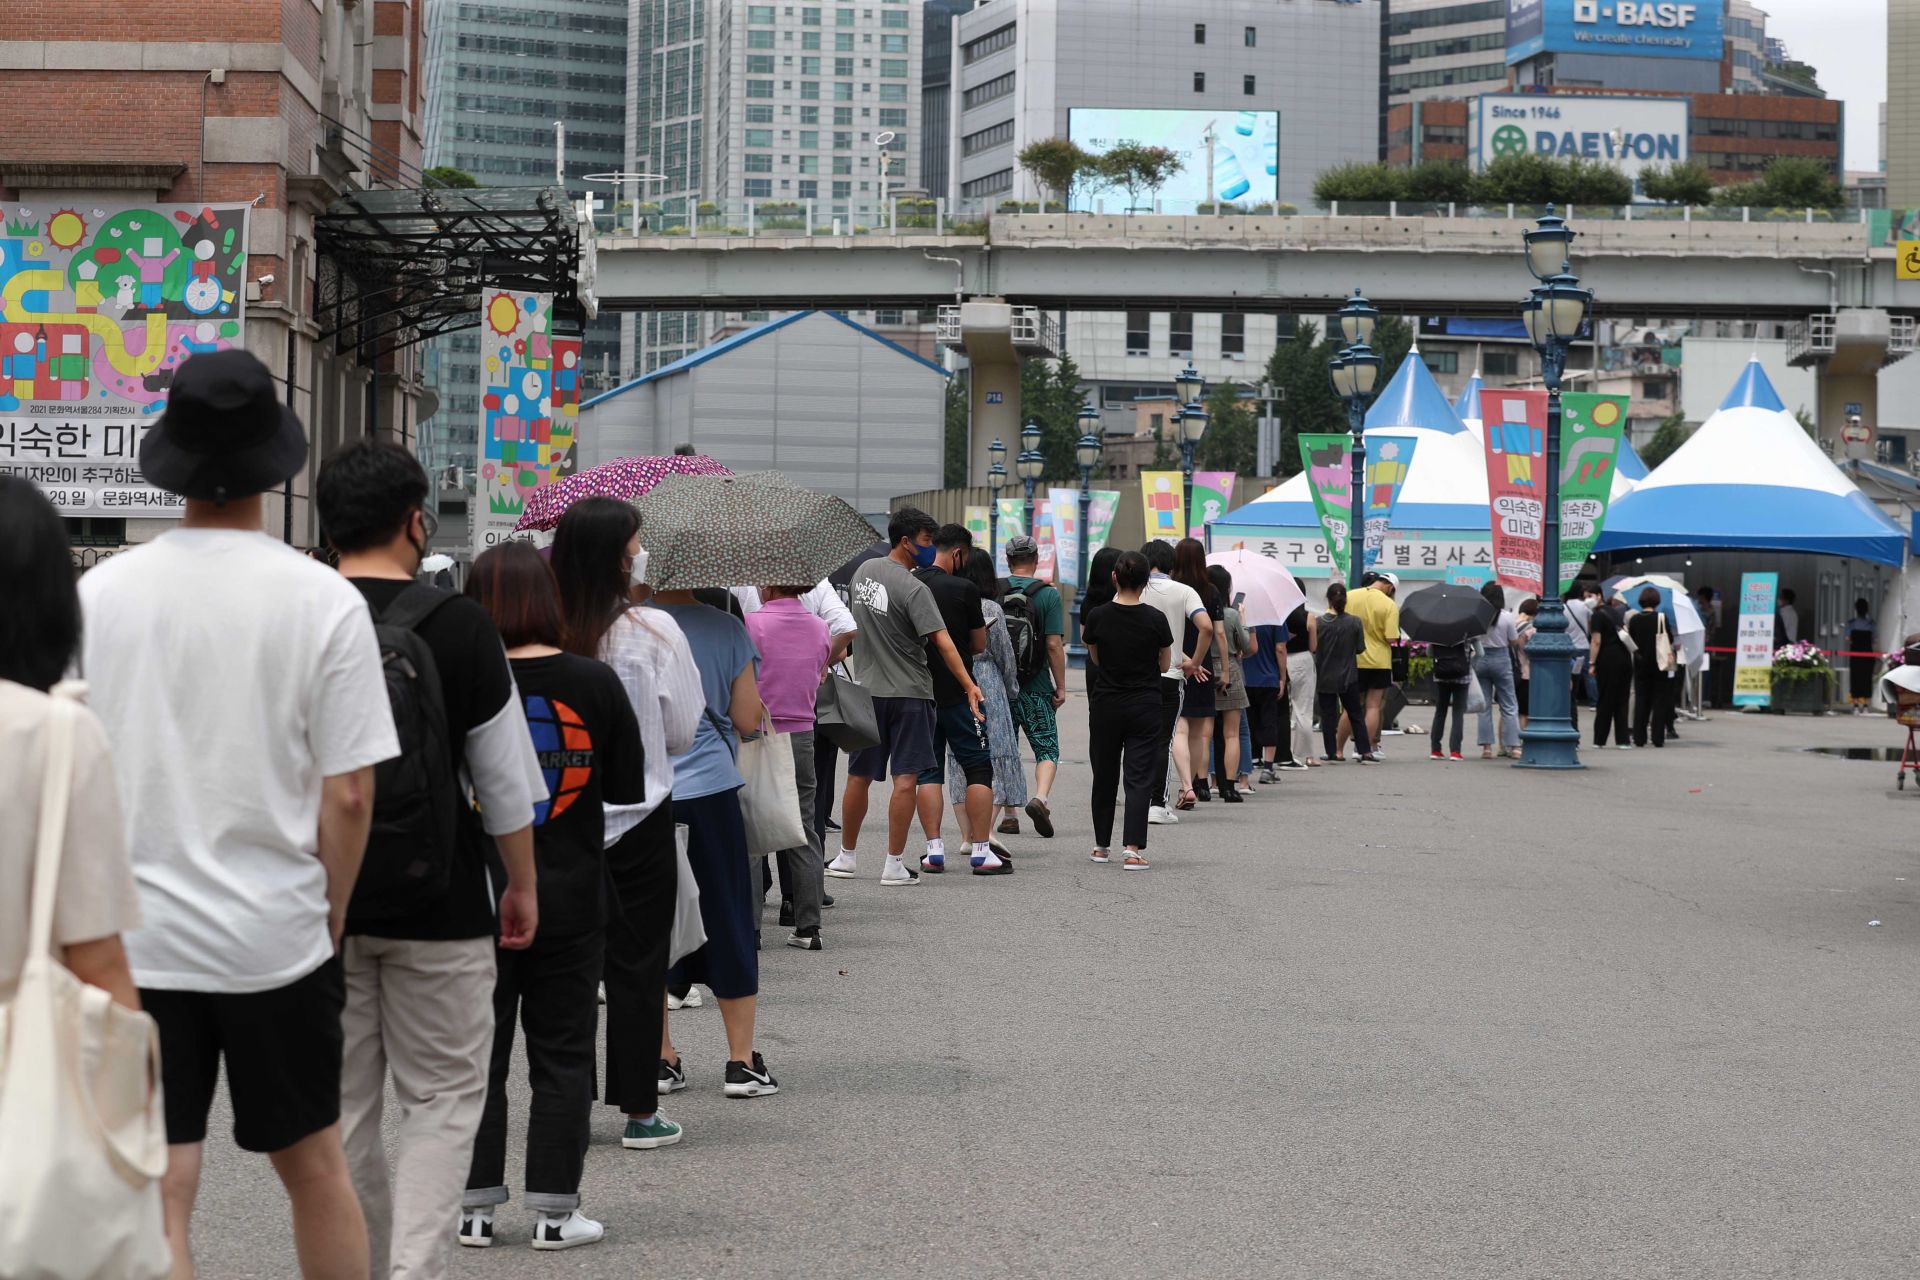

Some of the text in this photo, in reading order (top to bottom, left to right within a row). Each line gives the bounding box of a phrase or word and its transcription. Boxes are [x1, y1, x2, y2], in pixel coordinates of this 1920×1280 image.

[1616, 1, 1697, 28] BASF
[1574, 30, 1692, 48] We create chemistry
[1491, 105, 1561, 119] Since 1946
[1535, 131, 1680, 160] DAEWON
[30, 405, 135, 415] 2021 문화역서울284 기획전시
[0, 422, 152, 458] 익숙한 미
[82, 467, 144, 484] 추구하는
[103, 491, 186, 507] 문화역서울2
[1499, 499, 1540, 519] 익숙한
[865, 577, 880, 591] THE
[540, 751, 594, 768] ARKET
